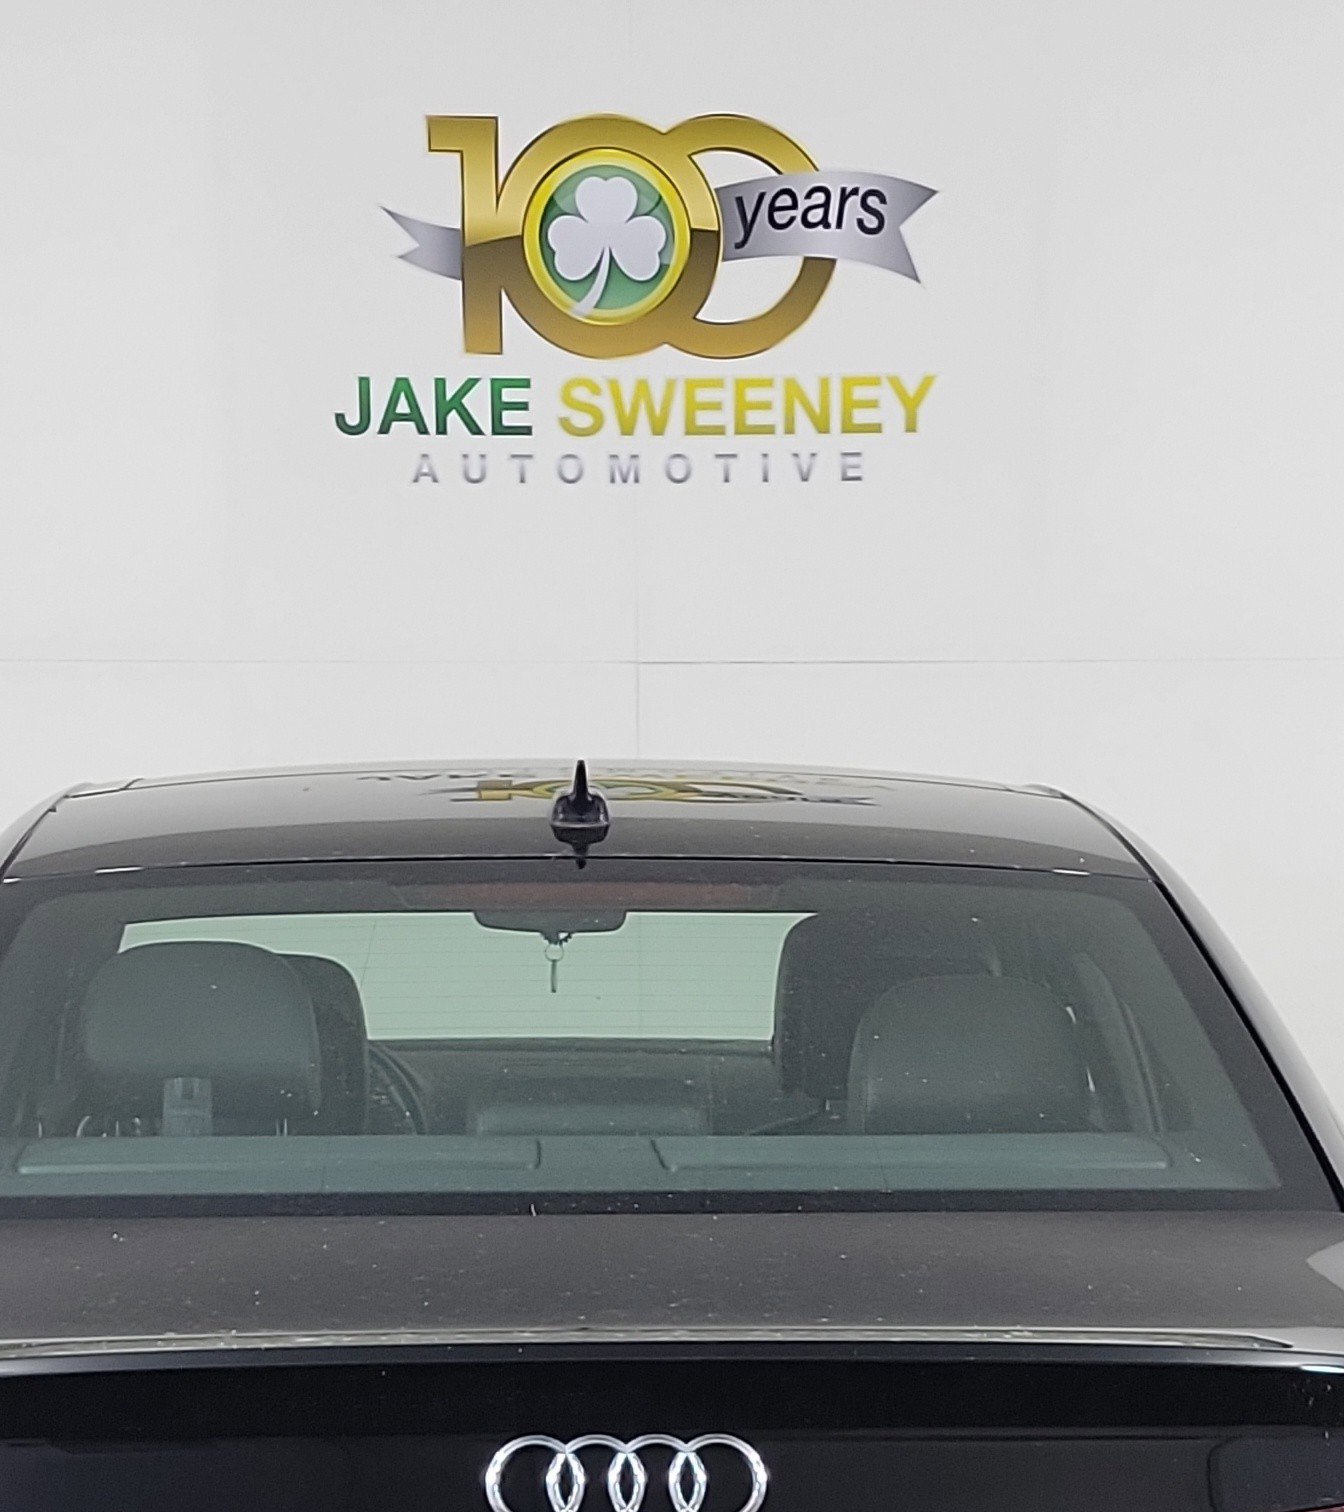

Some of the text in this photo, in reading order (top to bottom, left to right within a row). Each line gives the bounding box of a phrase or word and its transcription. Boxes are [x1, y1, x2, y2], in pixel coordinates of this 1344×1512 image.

[426, 113, 837, 359] 100
[734, 184, 888, 249] years
[334, 374, 939, 437] JAKE SWEENEY
[412, 452, 866, 484] AUTOMOTIVE
